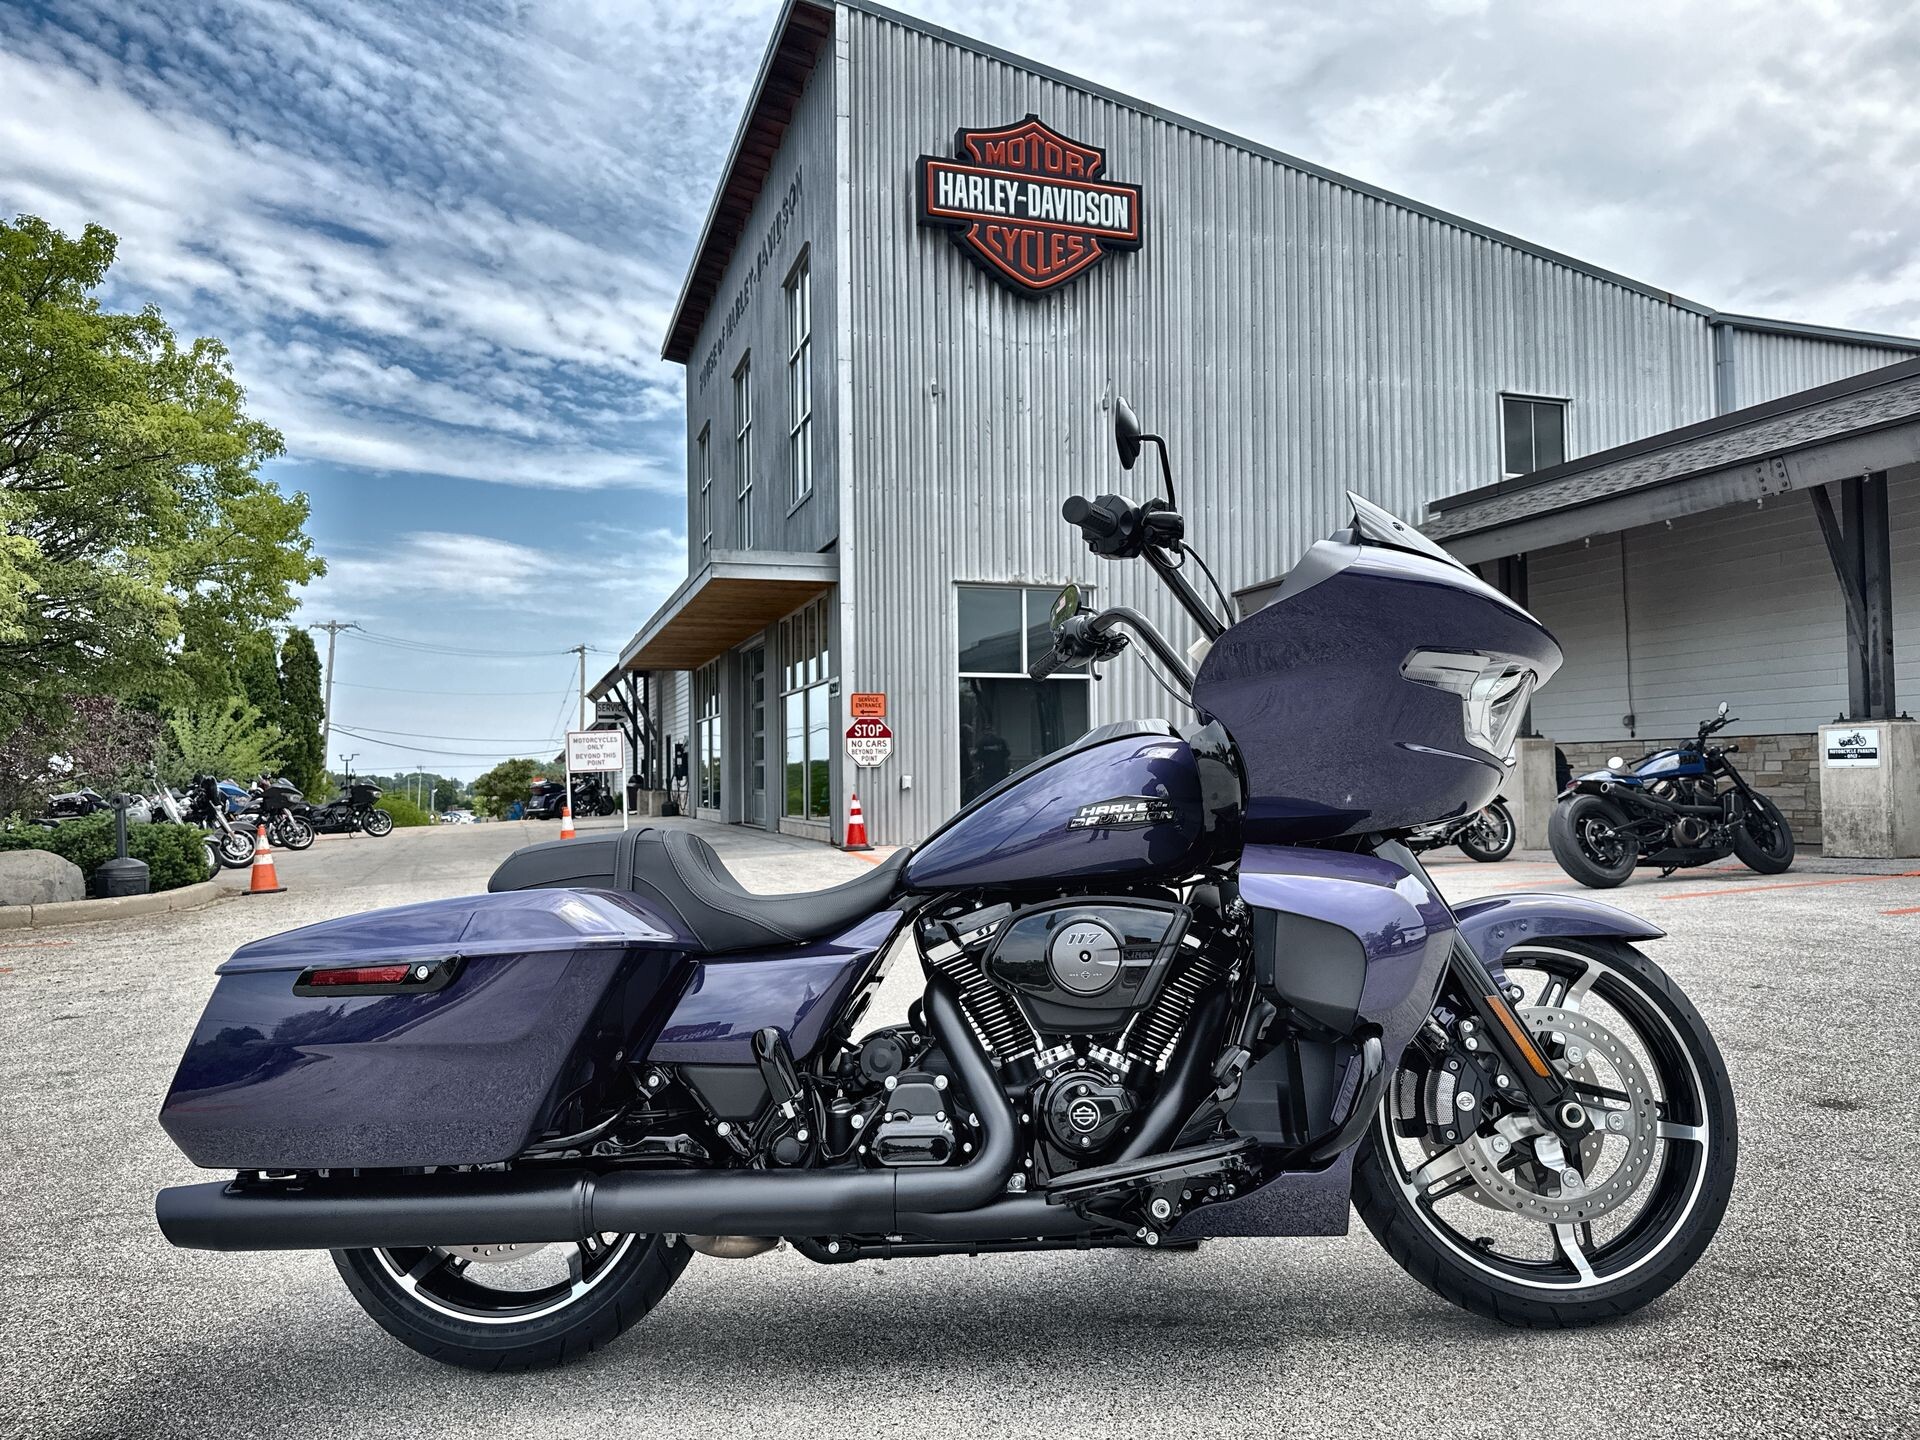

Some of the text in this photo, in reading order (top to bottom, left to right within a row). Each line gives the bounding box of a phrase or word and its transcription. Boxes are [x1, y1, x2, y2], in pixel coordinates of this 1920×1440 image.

[986, 132, 1085, 176] MOTOR
[938, 171, 1129, 230] HARLEY-DAVIDSON
[726, 165, 803, 339] HARLEY-DAVIDSON
[986, 225, 1084, 275] CYCLES
[854, 724, 884, 736] STOP
[865, 740, 888, 748] CARS
[1067, 932, 1104, 946] 117
